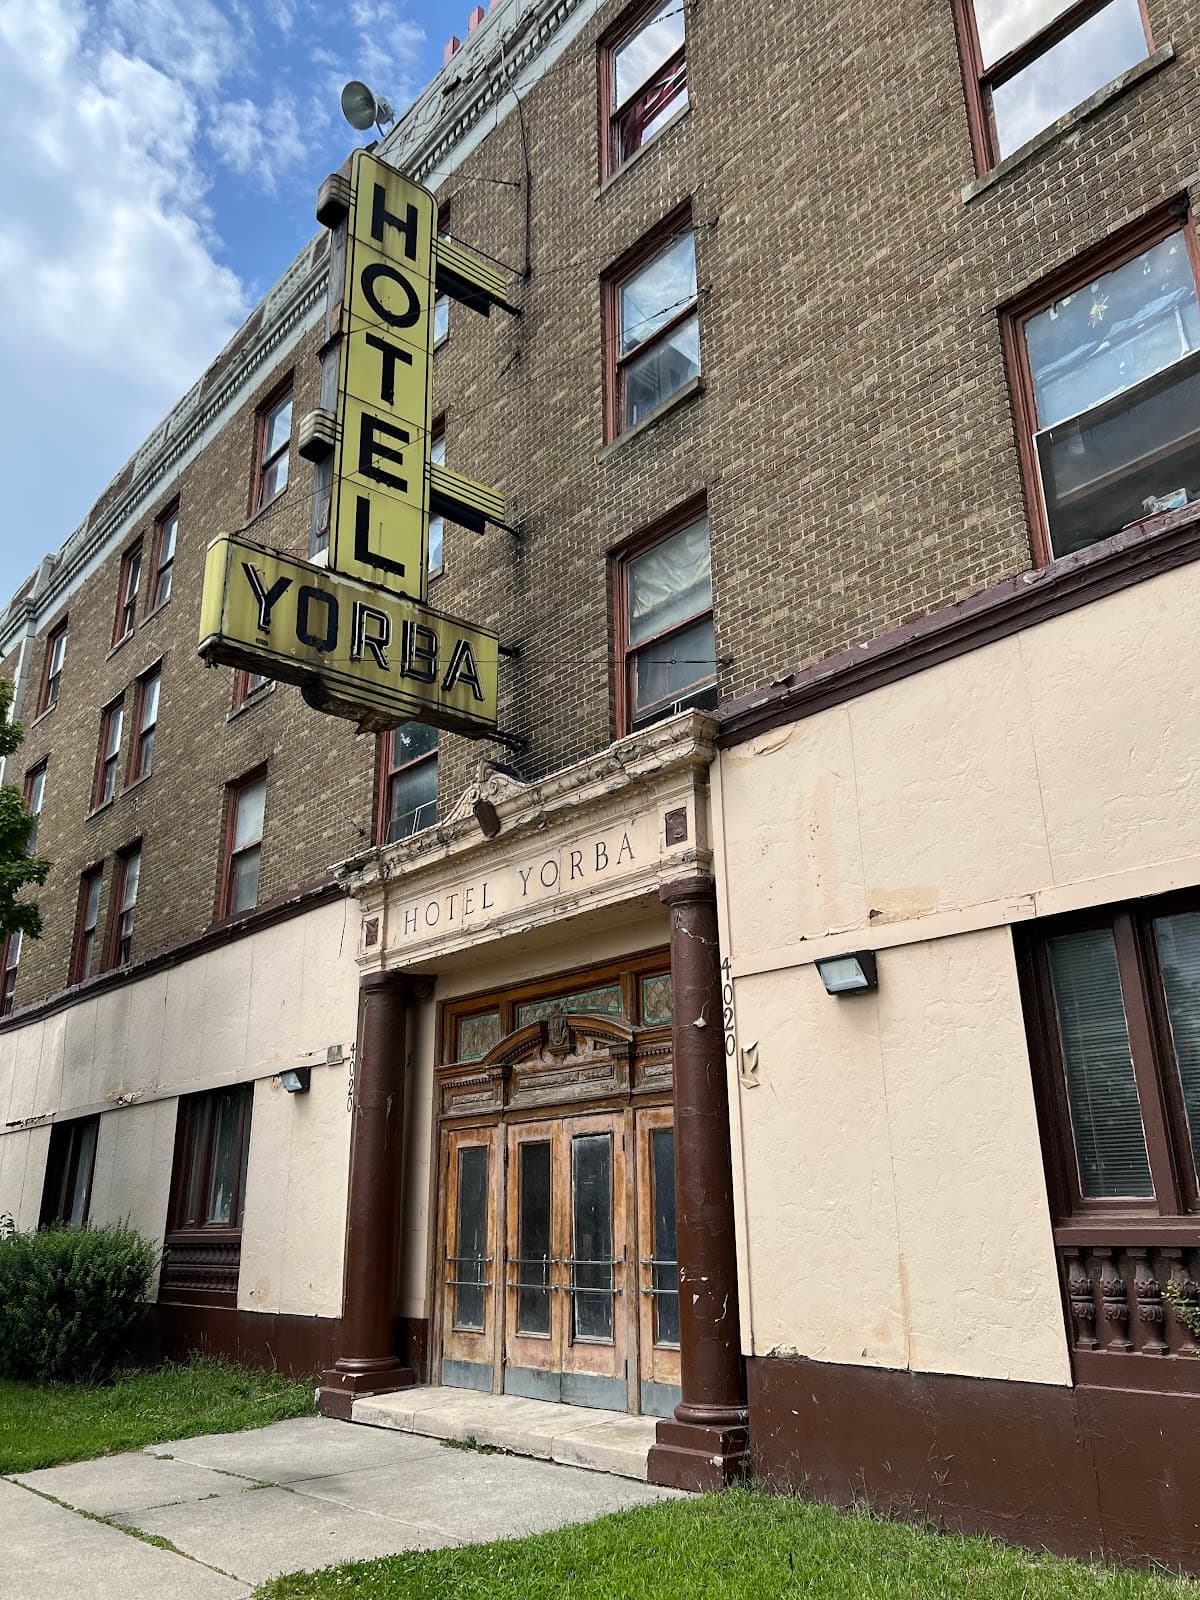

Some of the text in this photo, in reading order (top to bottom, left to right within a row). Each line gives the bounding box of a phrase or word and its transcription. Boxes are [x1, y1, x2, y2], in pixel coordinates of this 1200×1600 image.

[354, 183, 421, 577] HOTEL
[241, 561, 485, 702] YORBA
[404, 832, 636, 936] HOTEL YORBA
[720, 957, 736, 1056] 4020
[347, 1042, 357, 1112] 4020
